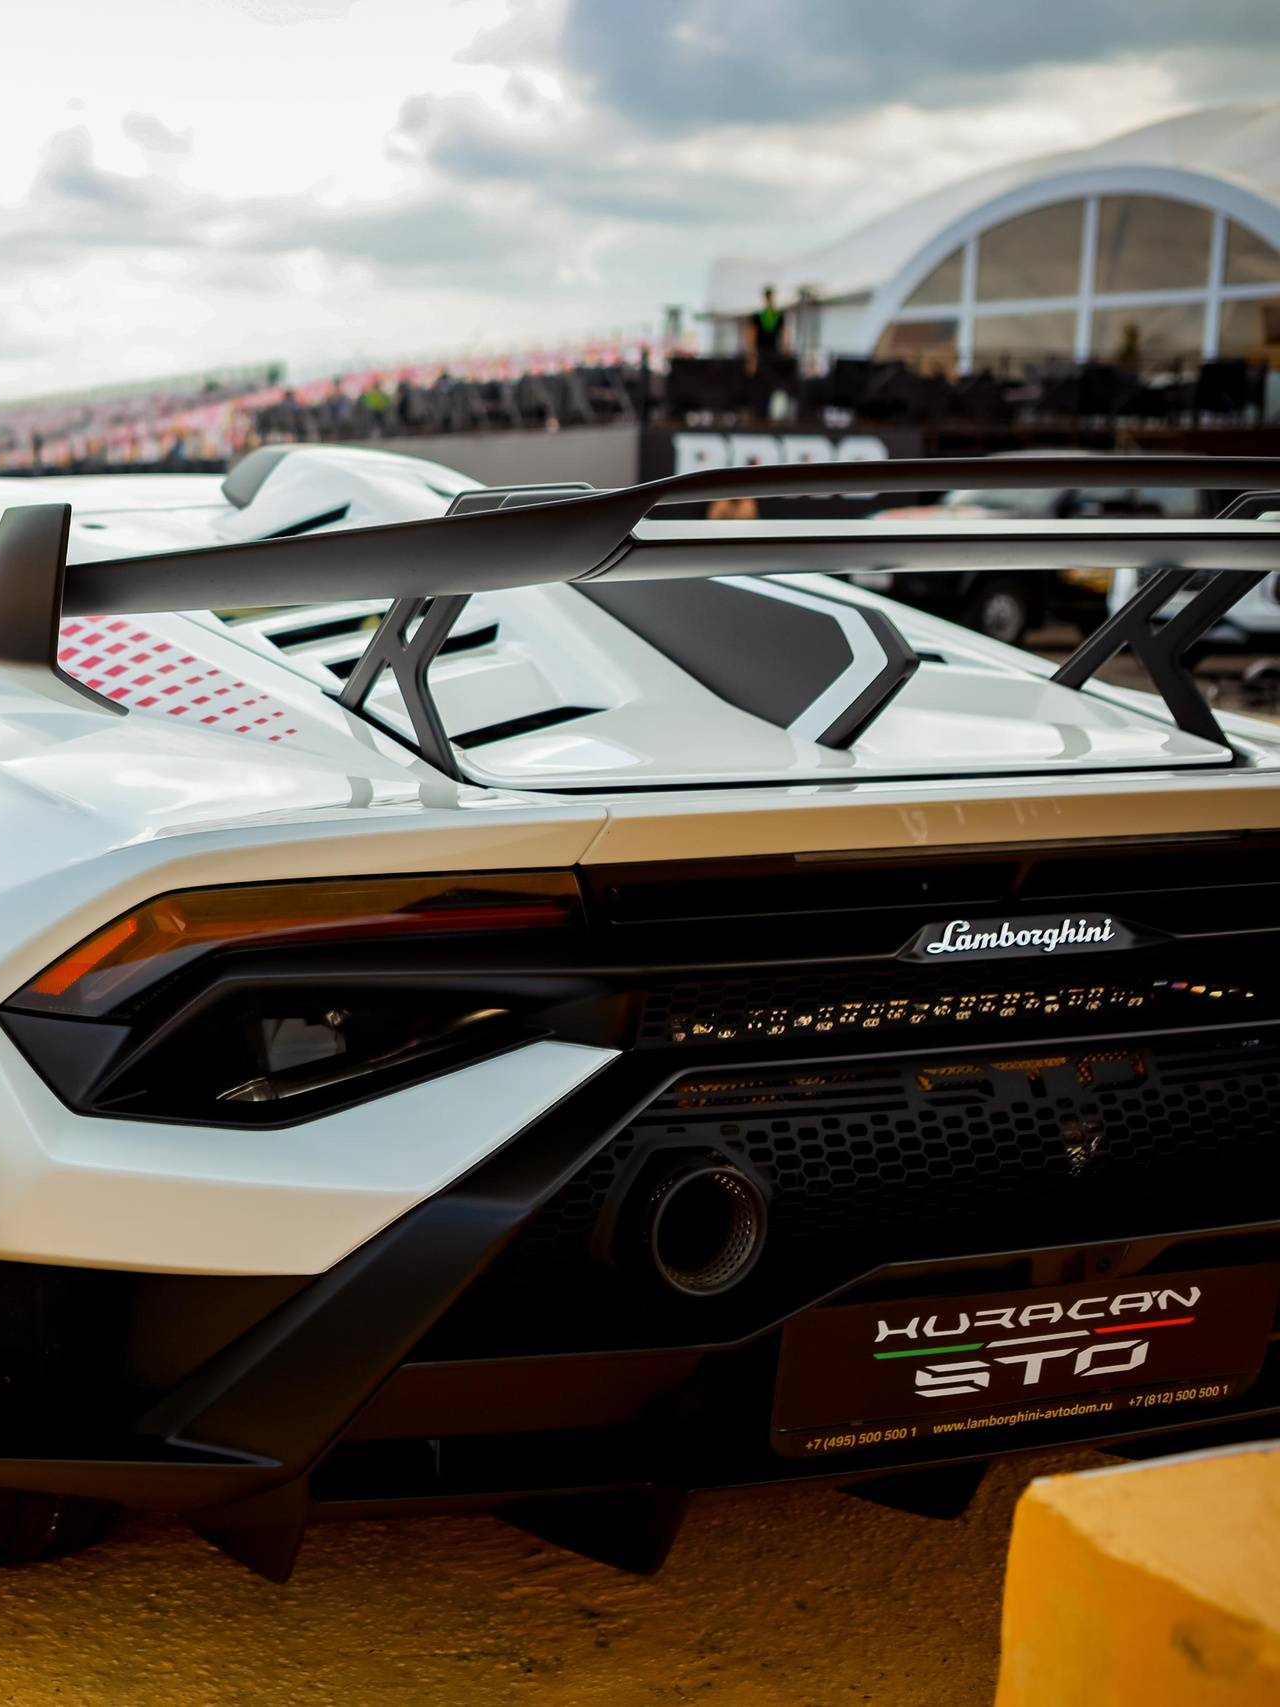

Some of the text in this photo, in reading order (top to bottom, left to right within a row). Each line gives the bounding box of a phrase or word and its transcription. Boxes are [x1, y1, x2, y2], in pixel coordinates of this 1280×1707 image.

[927, 918, 1116, 954] Lamborghini
[915, 1049, 1148, 1106] STO
[915, 1339, 1150, 1398] STO
[805, 1384, 1229, 1451] +7 (495) 500 500 1 www.lamborghini-avtodom.ru +7 (812) 500 500 1
